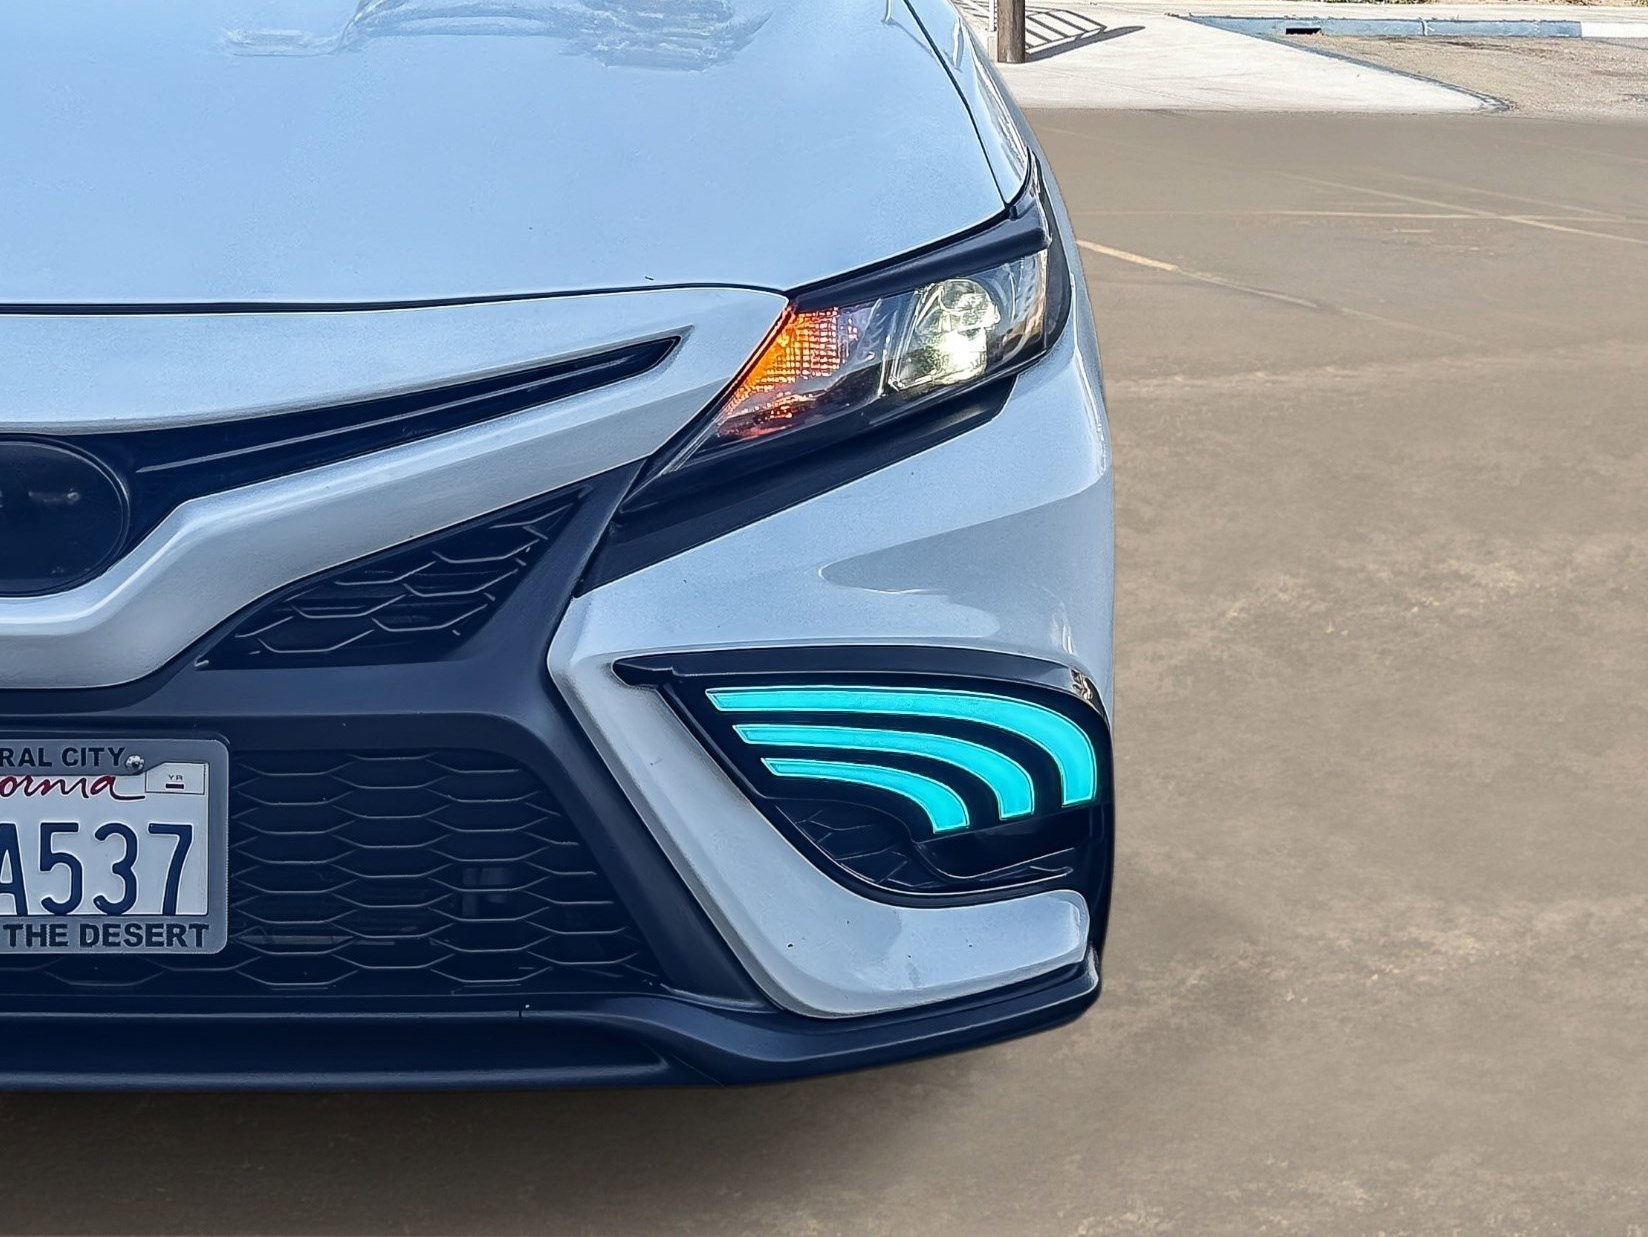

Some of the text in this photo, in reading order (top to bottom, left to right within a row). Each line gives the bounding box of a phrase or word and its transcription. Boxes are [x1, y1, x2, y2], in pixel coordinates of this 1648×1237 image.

[61, 746, 126, 768] CITY
[1, 923, 69, 948] THE
[79, 923, 210, 948] DESERT
